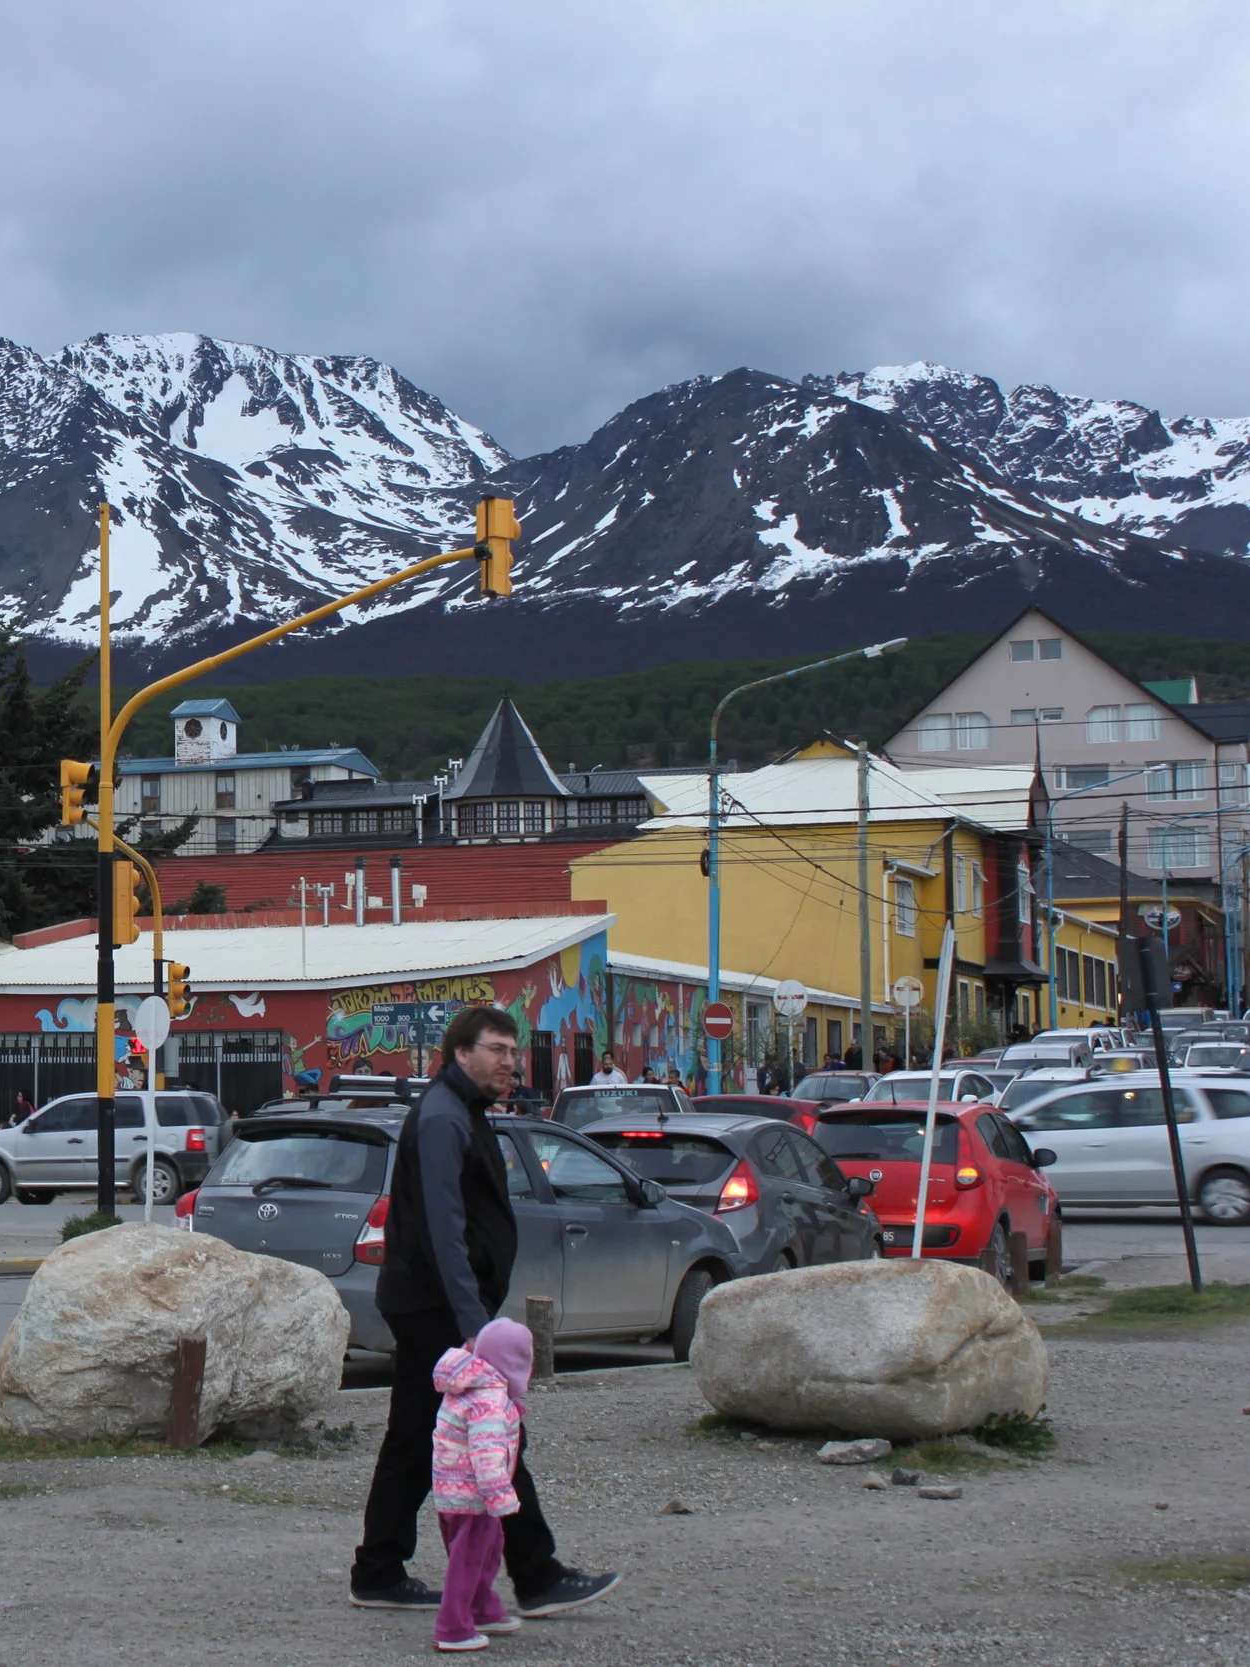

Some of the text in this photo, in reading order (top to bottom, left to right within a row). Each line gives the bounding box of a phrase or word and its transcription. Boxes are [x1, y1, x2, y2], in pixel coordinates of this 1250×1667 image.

[373, 1005, 395, 1013] Maipú
[373, 1014, 411, 1022] 1000 900
